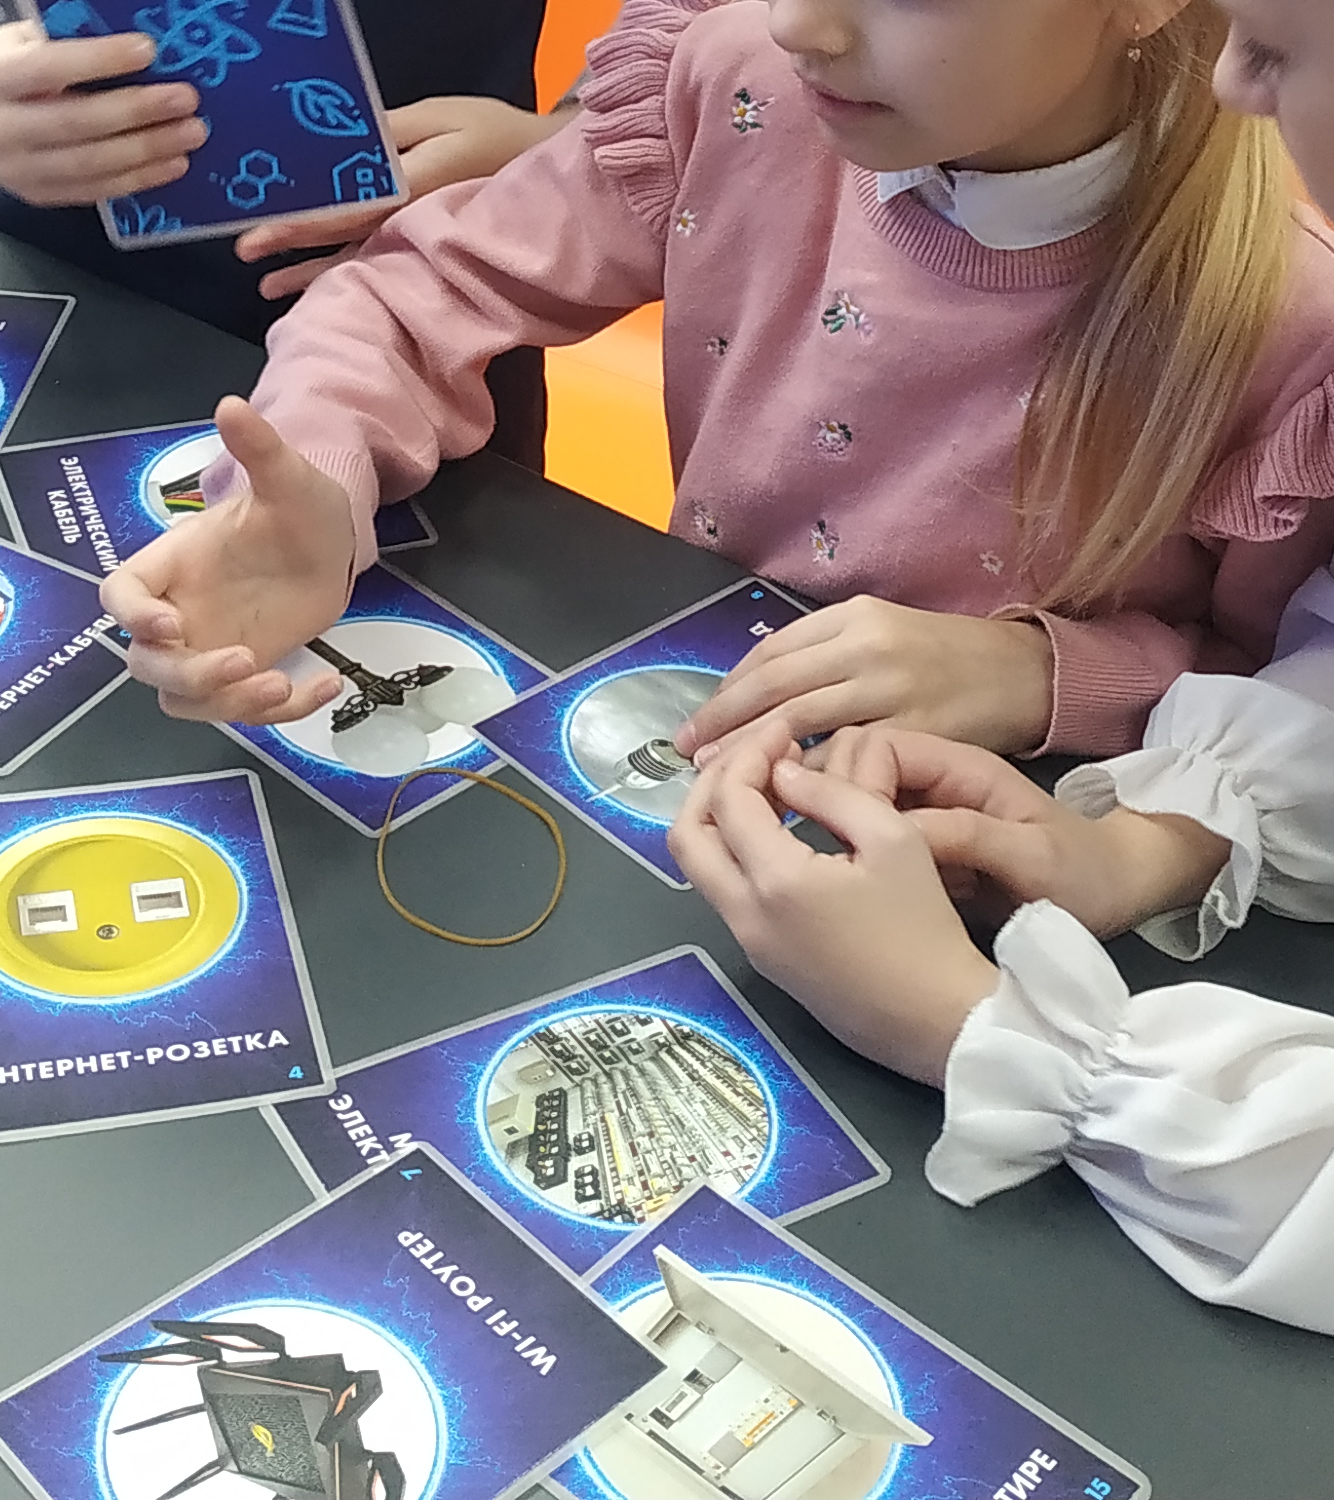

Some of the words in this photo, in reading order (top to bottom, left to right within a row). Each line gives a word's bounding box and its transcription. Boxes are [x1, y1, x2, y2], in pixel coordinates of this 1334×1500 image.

[47, 489, 82, 545] КАБЕЛЬ
[60, 455, 126, 572] ЭЛЕКТРИЧЕСКИЙ
[288, 1065, 304, 1079] 4
[396, 1229, 494, 1313] РОУТЕР
[484, 1308, 558, 1377] WI-FI
